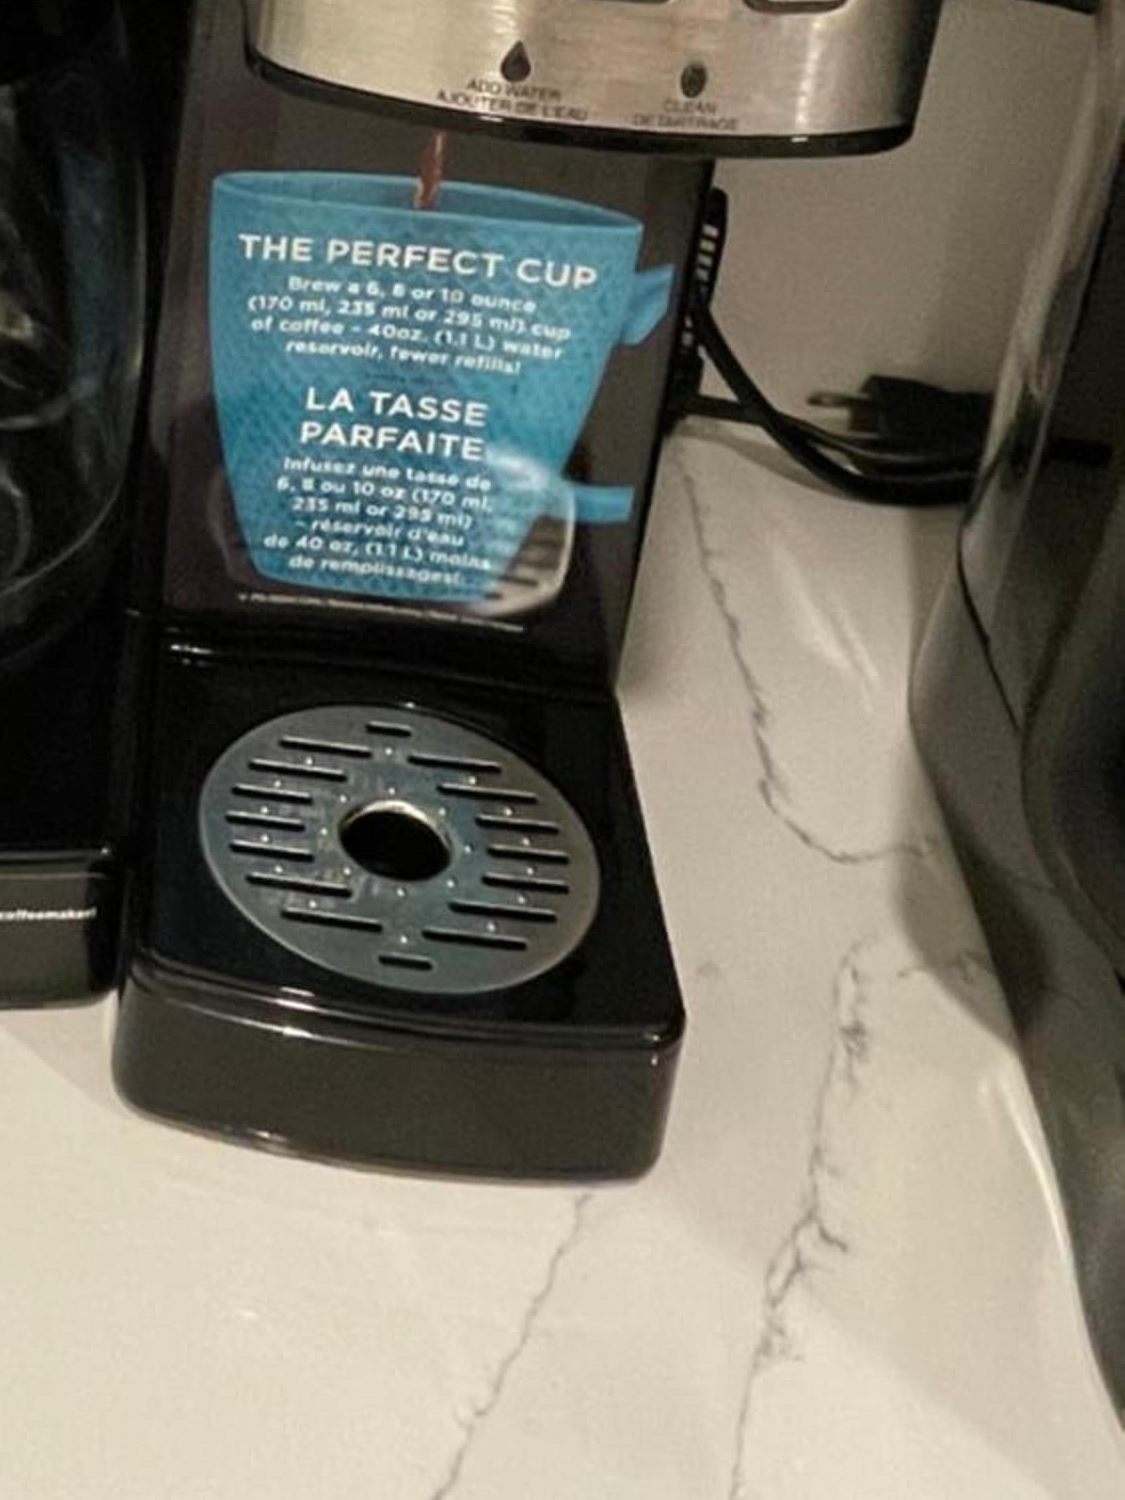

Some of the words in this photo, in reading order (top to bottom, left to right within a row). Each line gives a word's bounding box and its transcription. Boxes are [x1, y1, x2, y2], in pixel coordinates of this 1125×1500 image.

[466, 78, 503, 95] ADD
[506, 84, 563, 100] WATER
[237, 233, 315, 263] THE
[326, 238, 506, 279] PERFECT
[516, 257, 598, 290] CUP
[288, 275, 342, 293] Brew
[346, 282, 361, 295] a
[392, 282, 406, 298] 8
[410, 288, 435, 301] or
[441, 287, 466, 305] 10
[471, 293, 538, 313] ounce
[247, 294, 294, 312] (170
[299, 298, 331, 316] ml,
[336, 299, 376, 317] 235
[381, 304, 409, 319] ml
[414, 308, 437, 322] or
[443, 308, 483, 329] 295
[488, 316, 527, 335] ml)
[530, 322, 573, 342] cup
[250, 314, 274, 332] of
[278, 316, 346, 335] coffee
[475, 334, 496, 351] L)
[501, 338, 565, 360] water
[285, 339, 384, 361] reservoir,
[389, 344, 451, 366] fewer
[454, 352, 523, 375] refills!
[305, 385, 355, 413] LA
[368, 389, 490, 428] TASSE
[299, 419, 487, 462] PARFAITE
[283, 456, 356, 475] Infusez
[361, 464, 401, 480] une
[405, 466, 460, 487] tasse
[465, 474, 492, 492] de
[320, 480, 347, 494] ou
[352, 480, 376, 497] 10
[380, 486, 407, 501] oz
[411, 486, 456, 507] (170
[291, 496, 330, 513] 235
[334, 499, 361, 515] ml
[365, 503, 390, 517] or
[436, 510, 473, 531] ml)
[262, 532, 290, 549] de
[295, 535, 325, 551] 40
[428, 549, 492, 571] moins
[406, 526, 465, 547] d'eau
[288, 552, 316, 569] de
